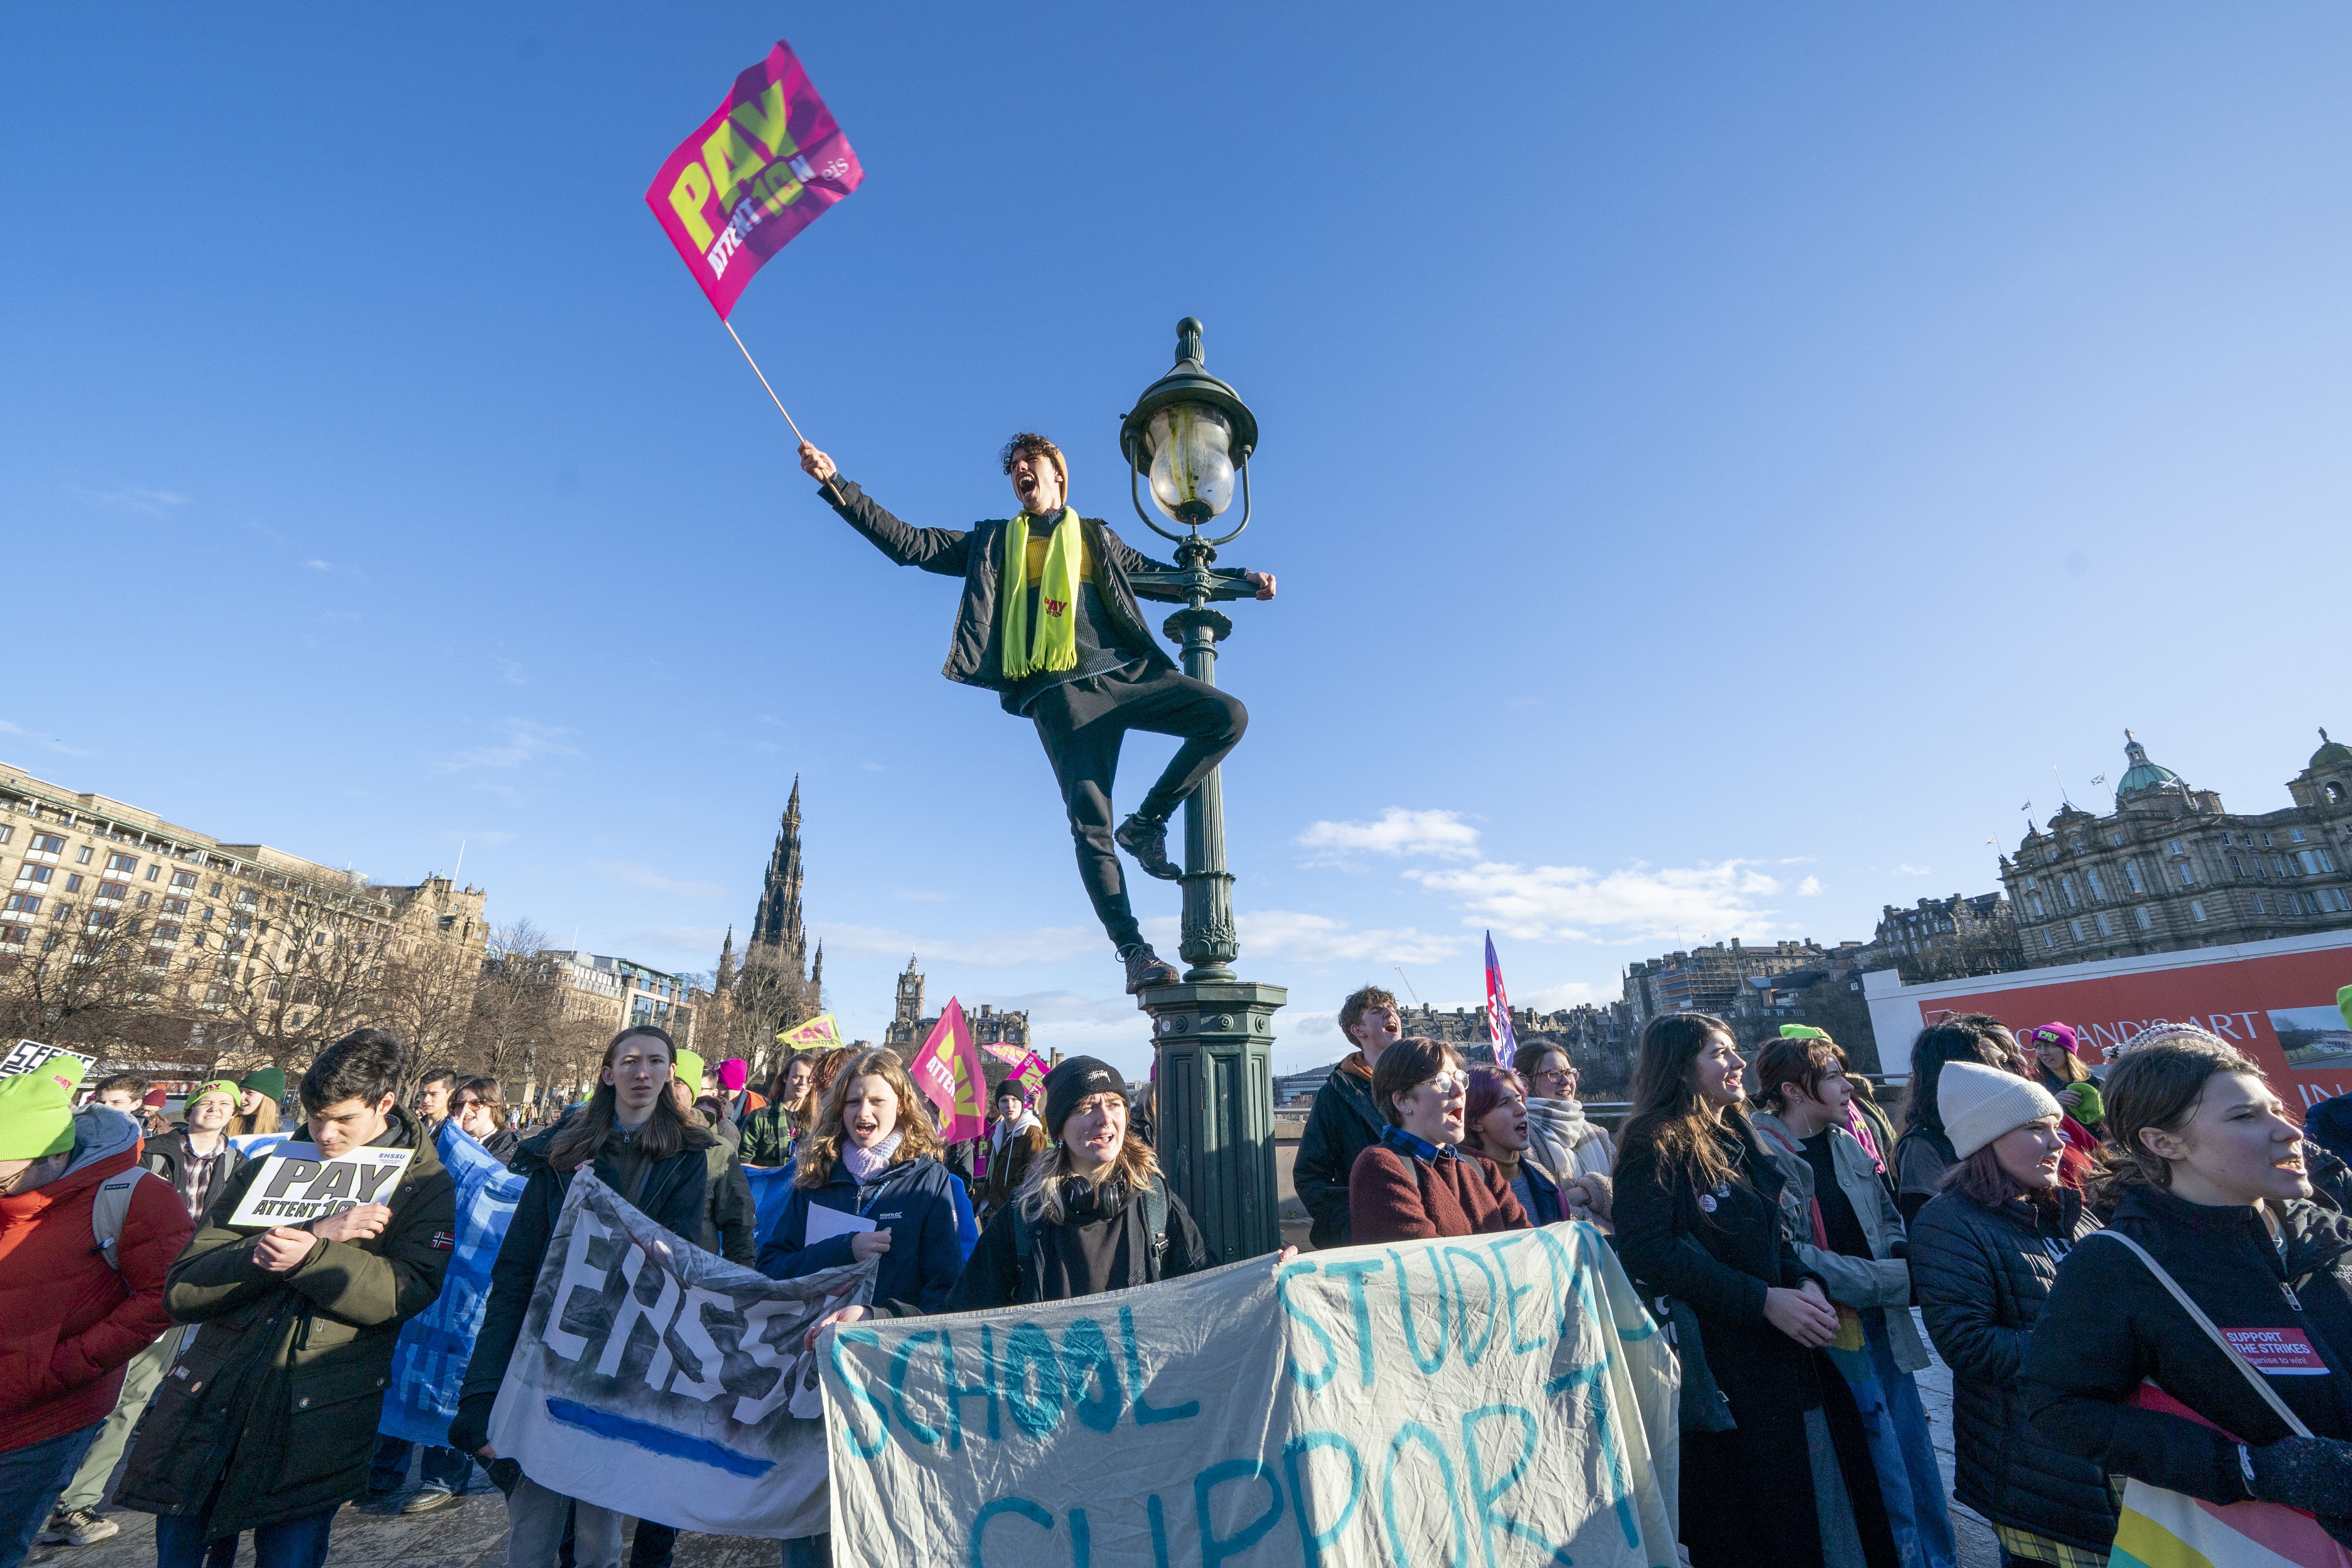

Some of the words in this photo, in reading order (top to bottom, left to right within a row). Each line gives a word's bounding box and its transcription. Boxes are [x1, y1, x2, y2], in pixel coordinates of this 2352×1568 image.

[668, 79, 799, 255] PAY
[779, 158, 807, 181] eis
[2038, 1030, 2059, 1040] PAY
[1024, 1056, 1034, 1066] eis
[54, 1075, 73, 1089] PAY
[1019, 1062, 1044, 1090] AY
[196, 1083, 221, 1097] PAY
[263, 1157, 400, 1203] PAY
[2226, 1332, 2283, 1342] SUPPORT
[2232, 1343, 2259, 1353] THE
[2258, 1343, 2311, 1354] STRIKES
[831, 1304, 1200, 1460] SCHOOL
